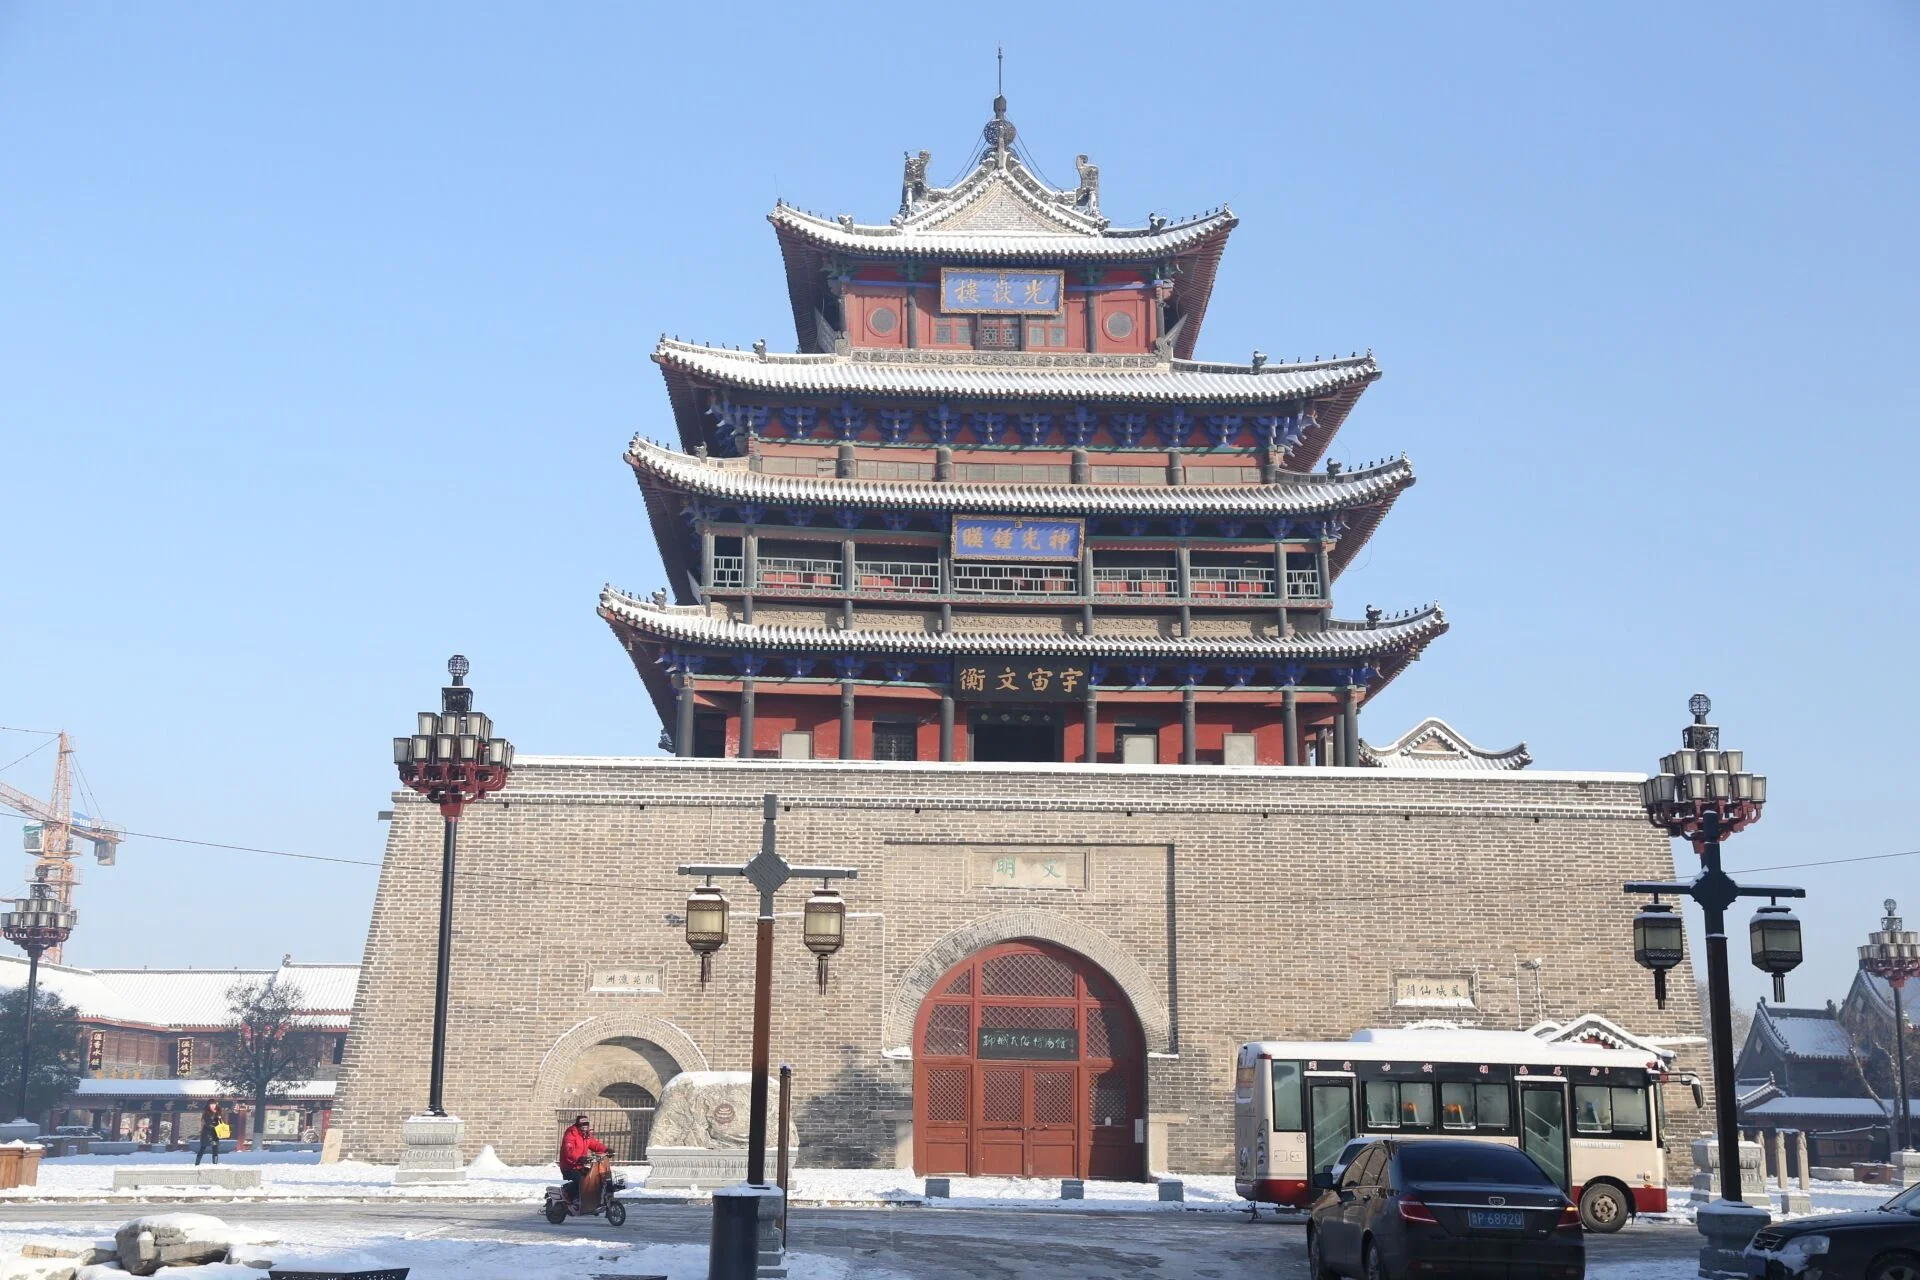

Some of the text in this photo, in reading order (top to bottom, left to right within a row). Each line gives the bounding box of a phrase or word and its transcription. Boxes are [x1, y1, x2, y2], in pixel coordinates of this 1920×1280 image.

[959, 666, 1084, 693] 宇宙文衡
[996, 855, 1061, 879] 文明
